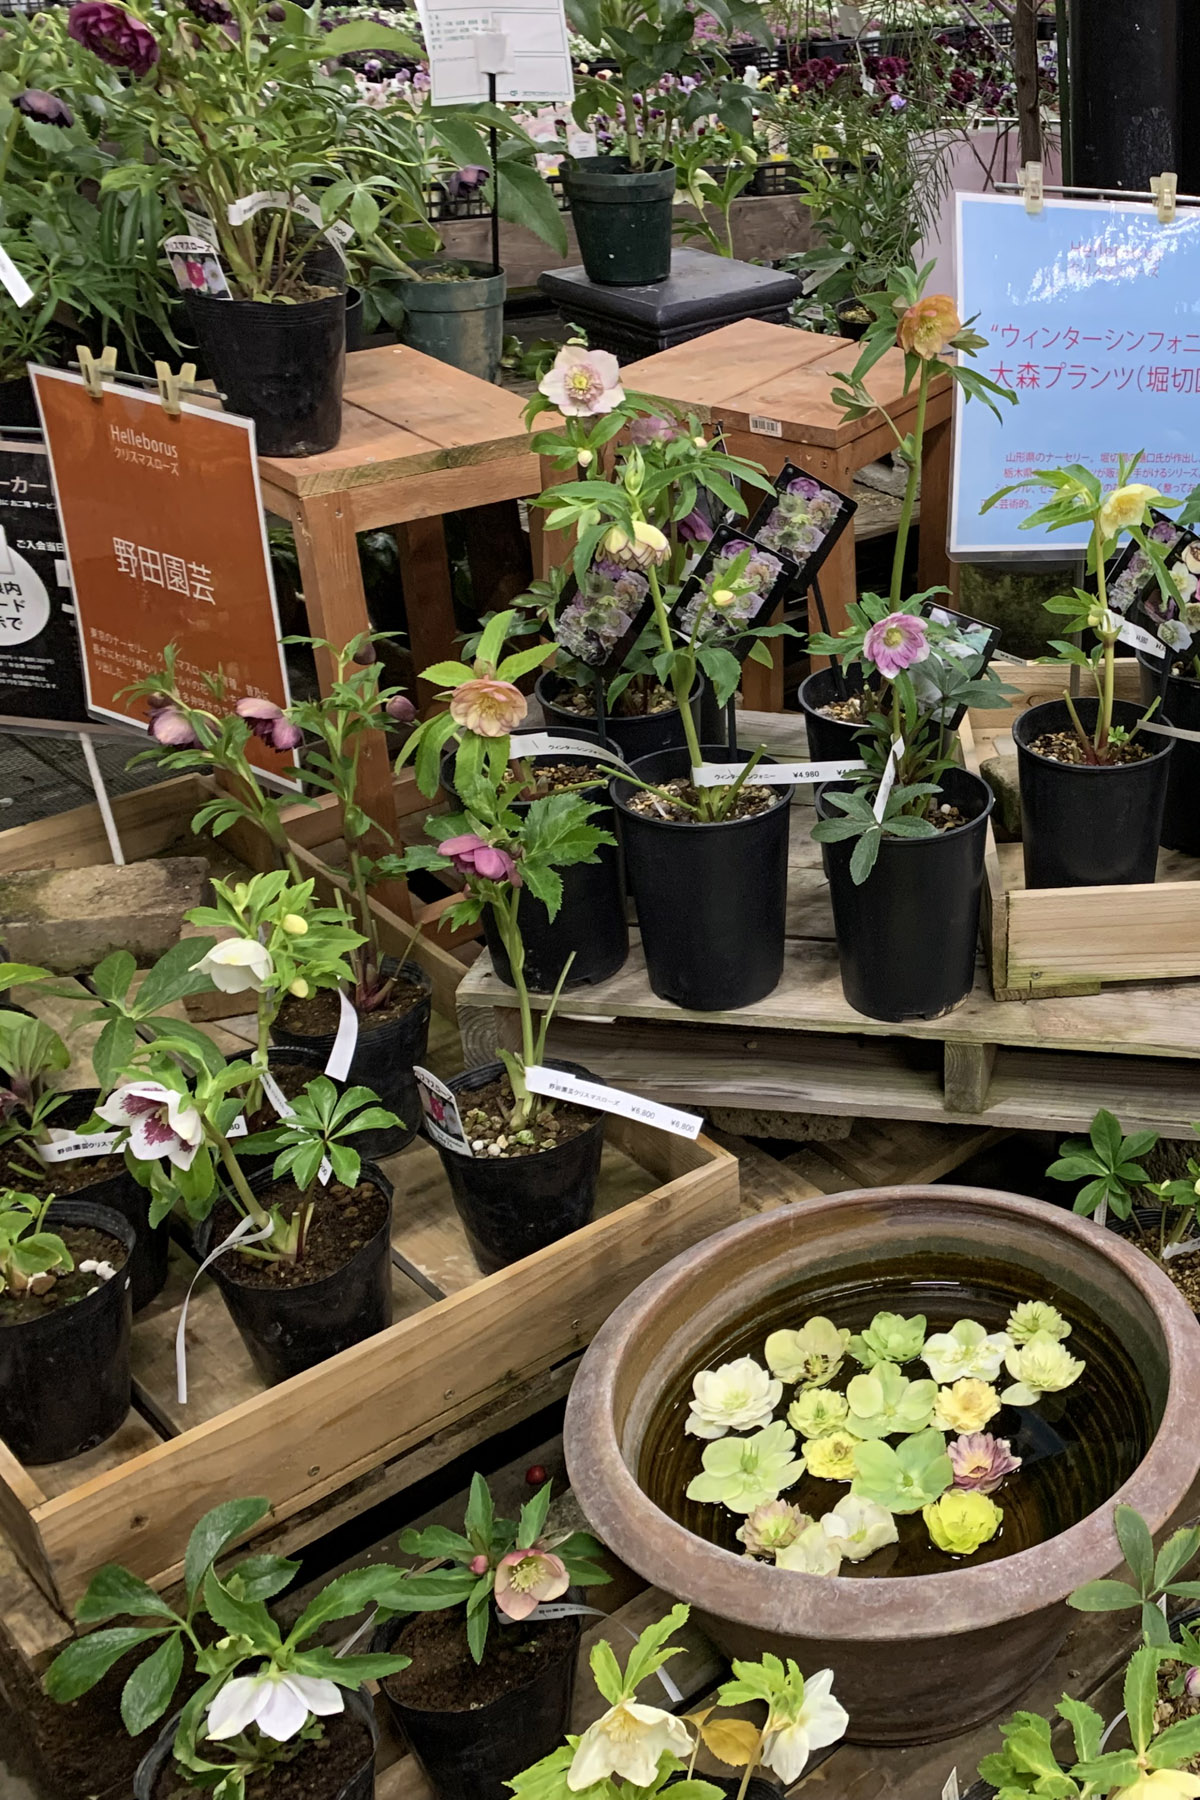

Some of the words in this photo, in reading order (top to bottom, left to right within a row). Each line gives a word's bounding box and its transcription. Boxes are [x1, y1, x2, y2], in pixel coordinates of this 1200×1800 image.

[110, 423, 179, 459] Helleborus
[114, 447, 180, 478] クリスマスローズ
[112, 536, 216, 606] 野田園芸
[630, 1104, 656, 1121] ¥6,800
[670, 1118, 696, 1134] ¥6,800
